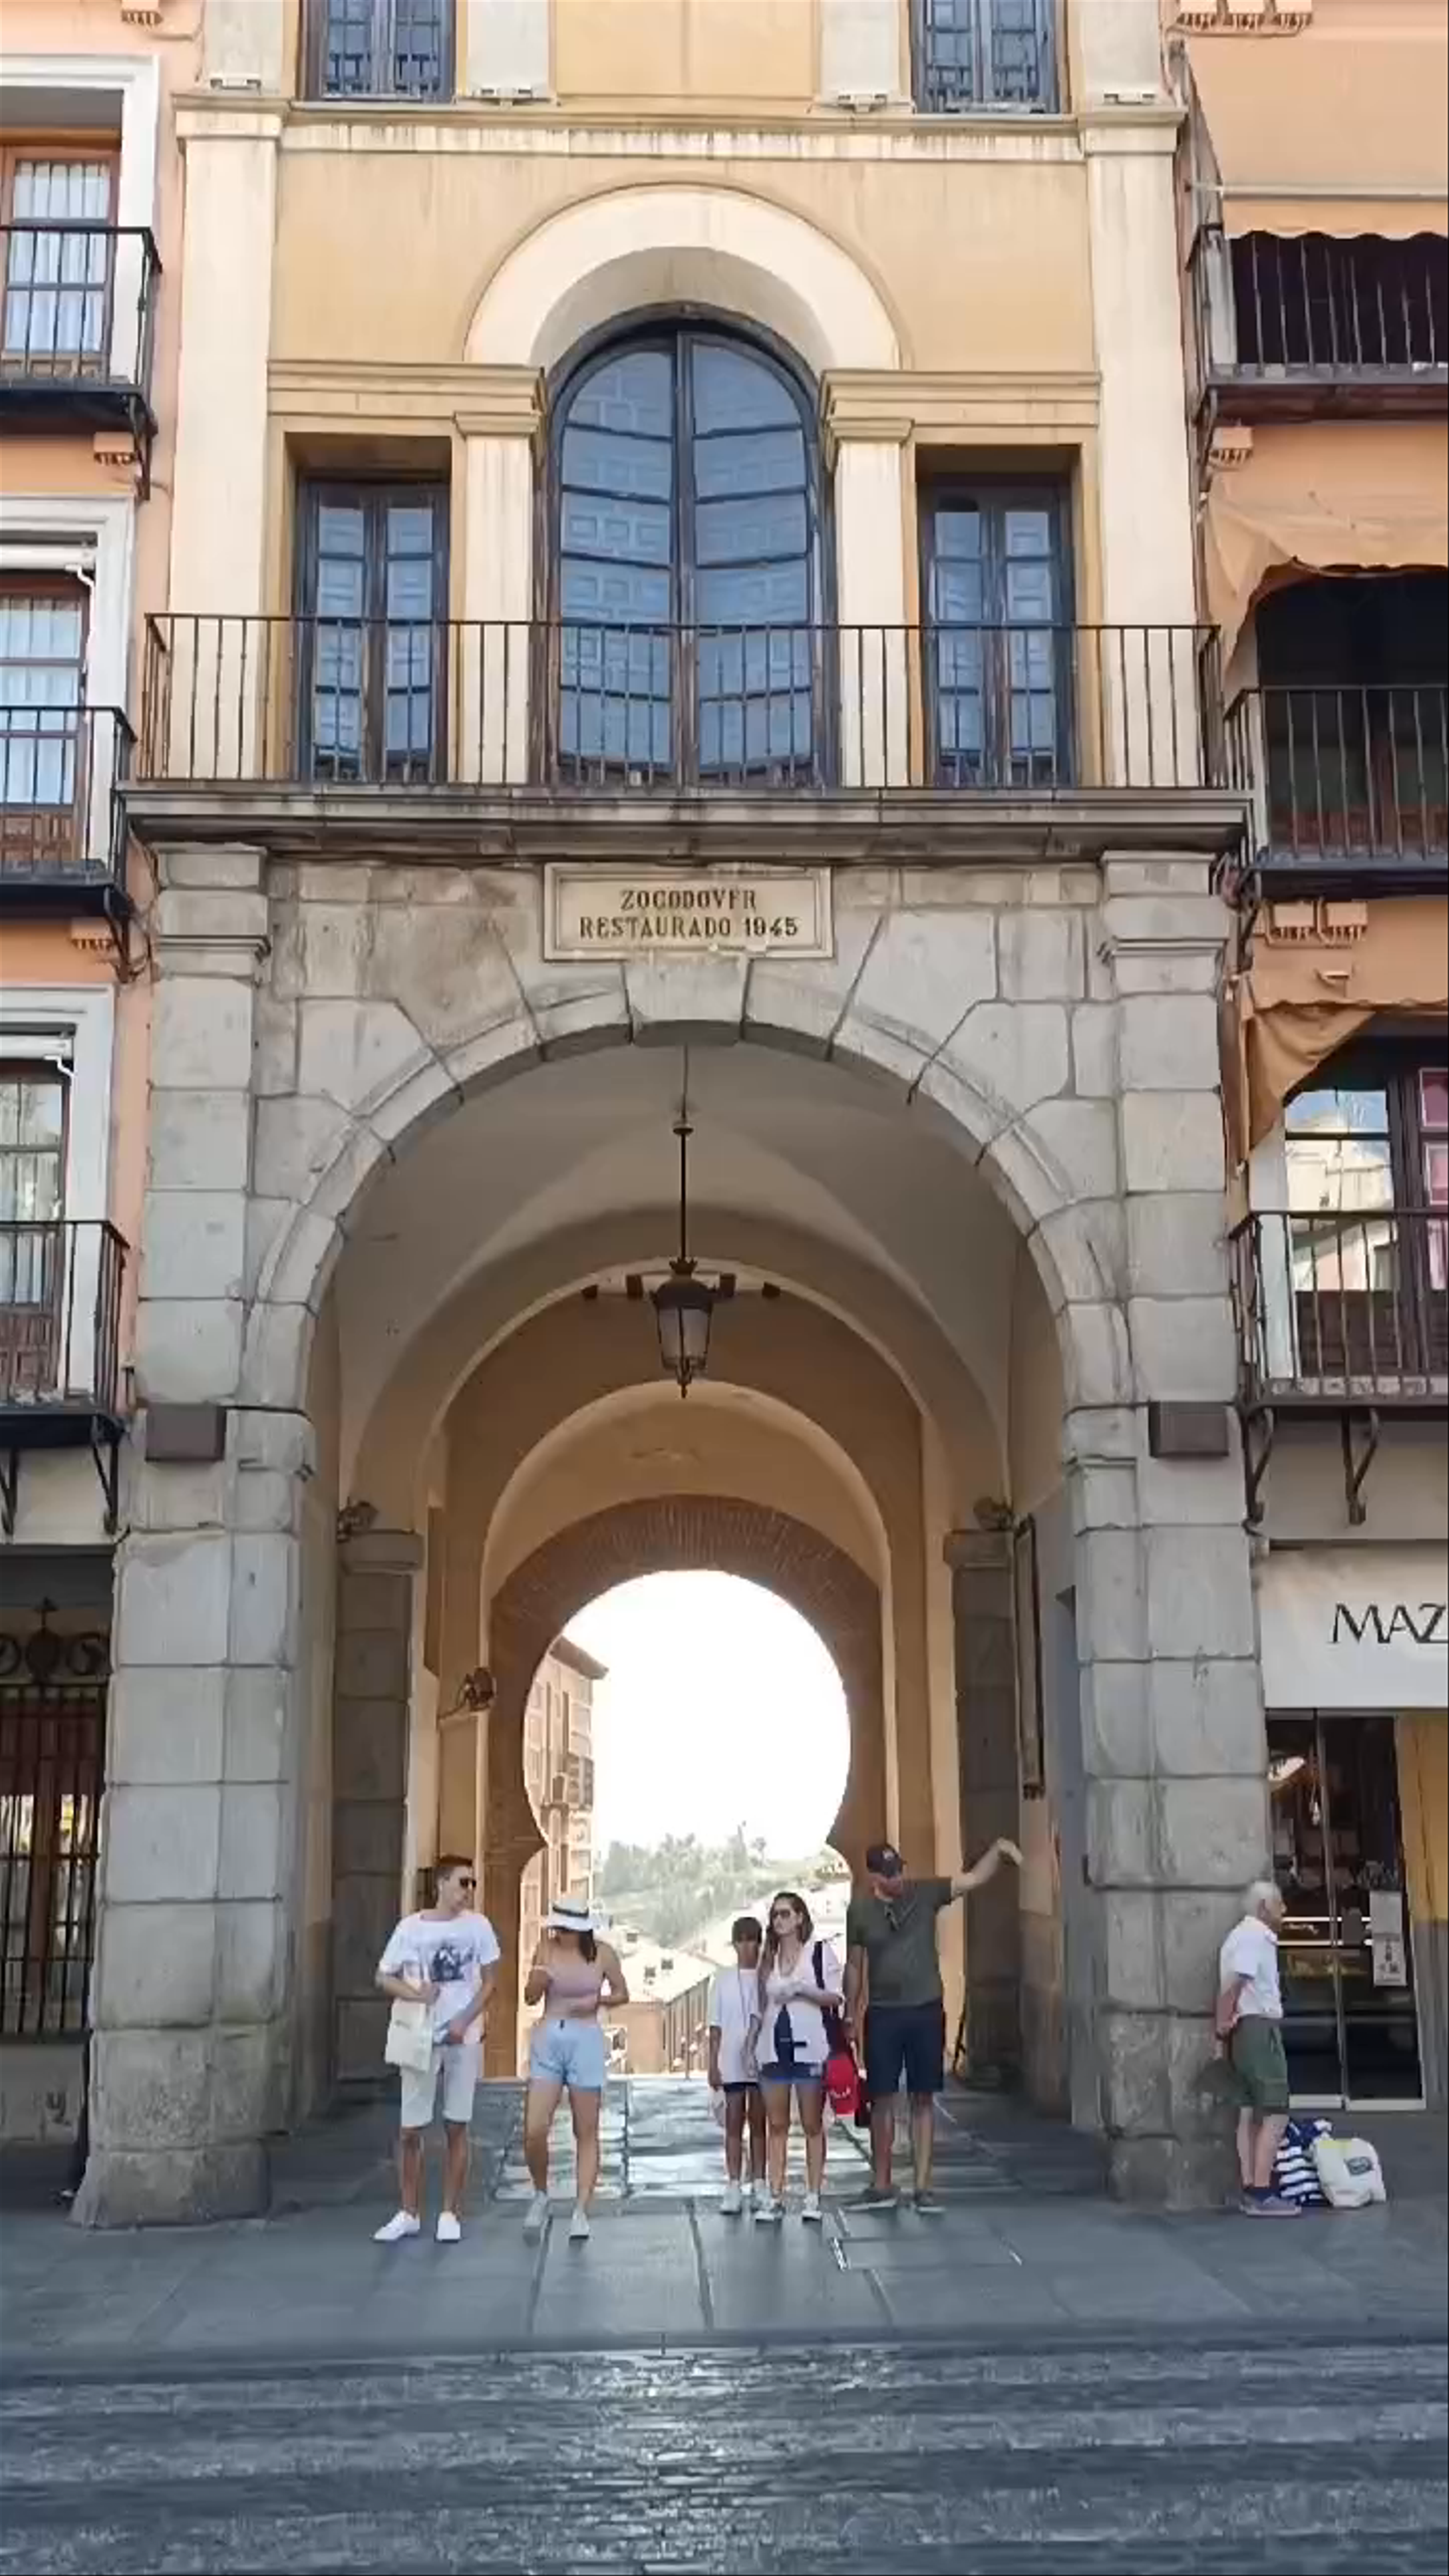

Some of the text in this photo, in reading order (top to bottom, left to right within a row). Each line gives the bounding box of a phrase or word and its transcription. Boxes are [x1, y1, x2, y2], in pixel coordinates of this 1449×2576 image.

[620, 889, 756, 910] ZOCODOVER
[580, 916, 798, 939] RESTAURADO 1945
